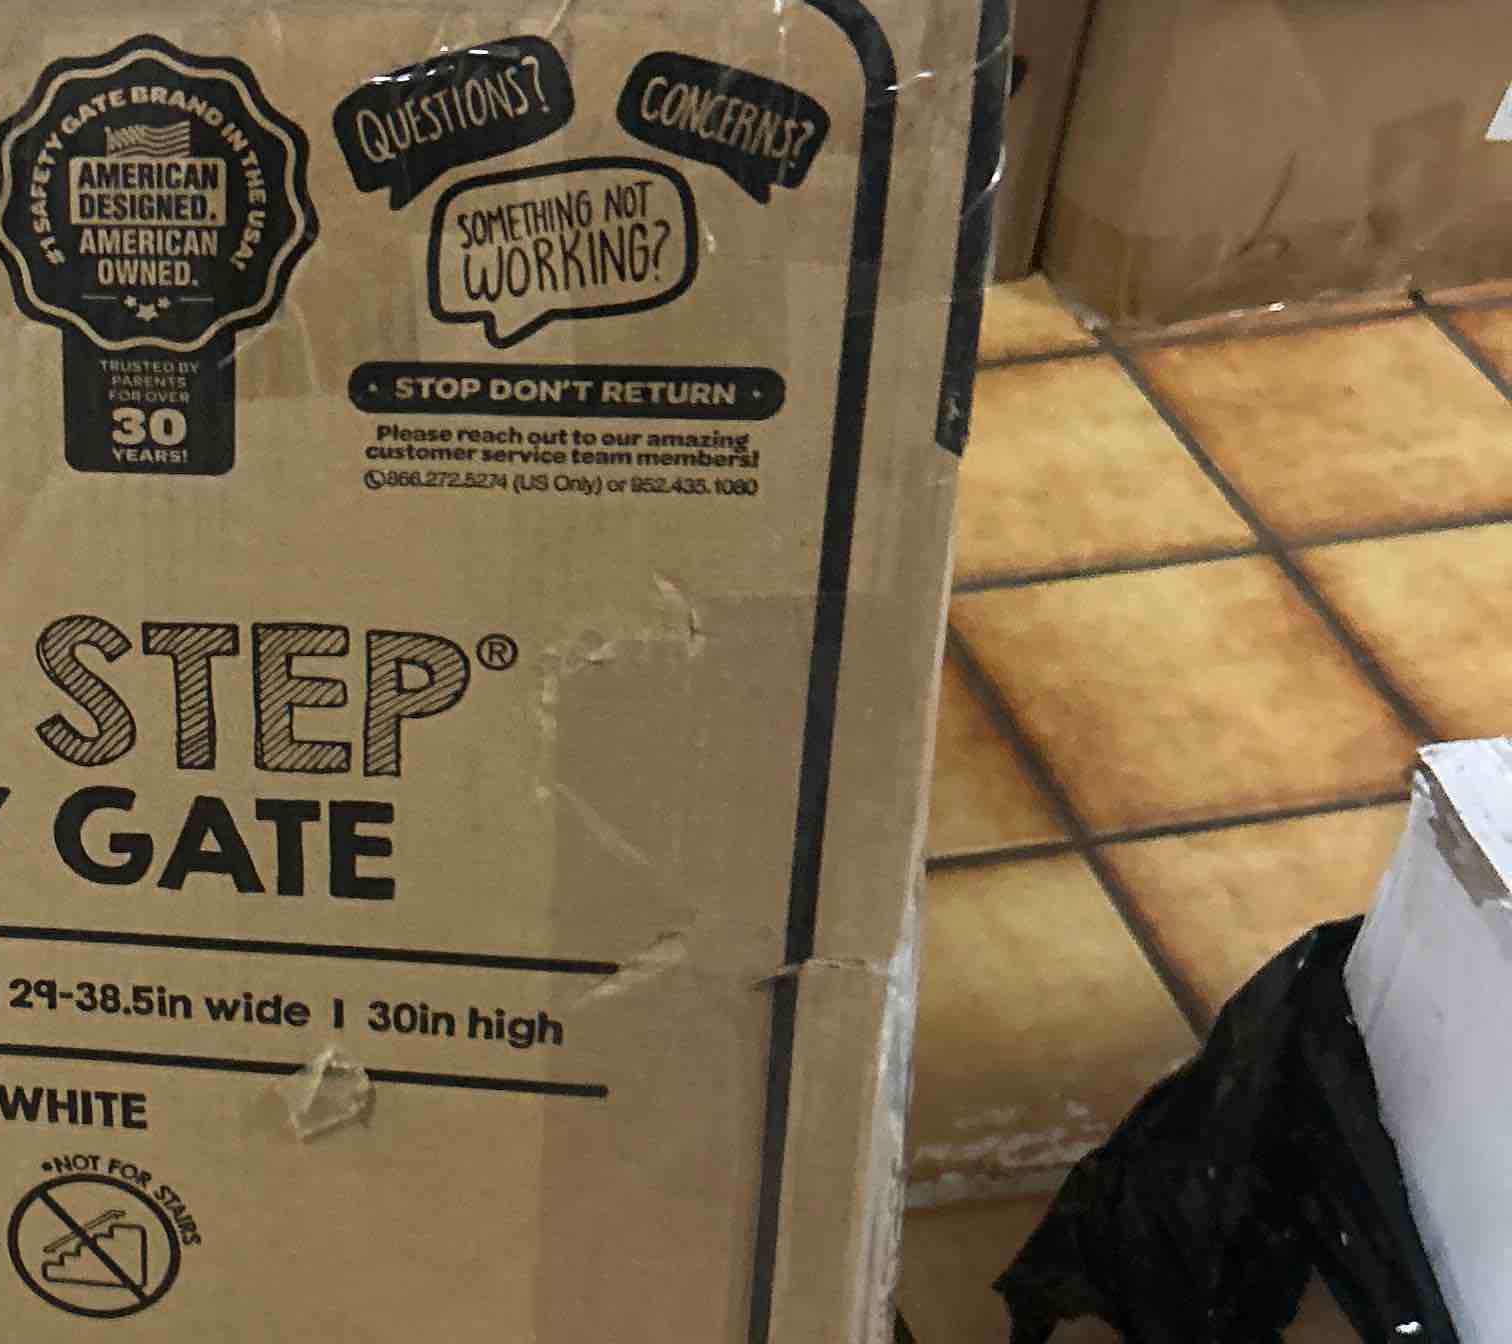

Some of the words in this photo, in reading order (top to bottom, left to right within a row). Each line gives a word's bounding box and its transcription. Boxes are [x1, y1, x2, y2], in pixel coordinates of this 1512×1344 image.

[356, 56, 551, 164] QUESTIONS?
[640, 76, 816, 168] CONCERNS?
[31, 132, 63, 233] SAFETY
[61, 88, 126, 134] GATE
[130, 85, 223, 126] BRAND
[221, 122, 248, 152] IN
[240, 151, 266, 205] THE
[79, 163, 218, 190] AMERICAN
[79, 194, 217, 221] DESIGNED.
[457, 190, 593, 250] SOMETHING
[604, 181, 654, 222] NOT
[79, 228, 218, 256] AMERICAN
[98, 259, 198, 286] OWNED.
[462, 219, 671, 303] WORKING?
[101, 359, 175, 373] TRUSTED
[179, 360, 200, 374] BY
[108, 390, 141, 403] FOR
[145, 390, 190, 403] OVER
[111, 375, 187, 389] PARENTS
[394, 376, 480, 401] STOP
[489, 378, 594, 402] DON'T
[601, 380, 736, 405] RETURN
[111, 408, 187, 446] 30
[376, 424, 453, 442] Please
[457, 426, 522, 444] reach
[527, 429, 568, 445] out
[572, 430, 597, 446] to
[601, 432, 642, 447] our
[647, 429, 750, 453] amazing
[111, 447, 188, 463] YEARS!
[365, 444, 477, 460] customer
[480, 446, 567, 463] service
[571, 449, 632, 464] team
[638, 450, 759, 468] members!
[513, 474, 549, 494] (US
[553, 474, 602, 495] Only)
[606, 478, 627, 492] or
[55, 785, 396, 900] GATE
[8, 978, 193, 1020] 29-38.5in
[205, 993, 310, 1028] wide
[368, 1001, 455, 1037] 30in
[467, 1006, 564, 1049] high
[108, 1158, 152, 1188] FOR
[154, 1185, 202, 1247] STAIRS
